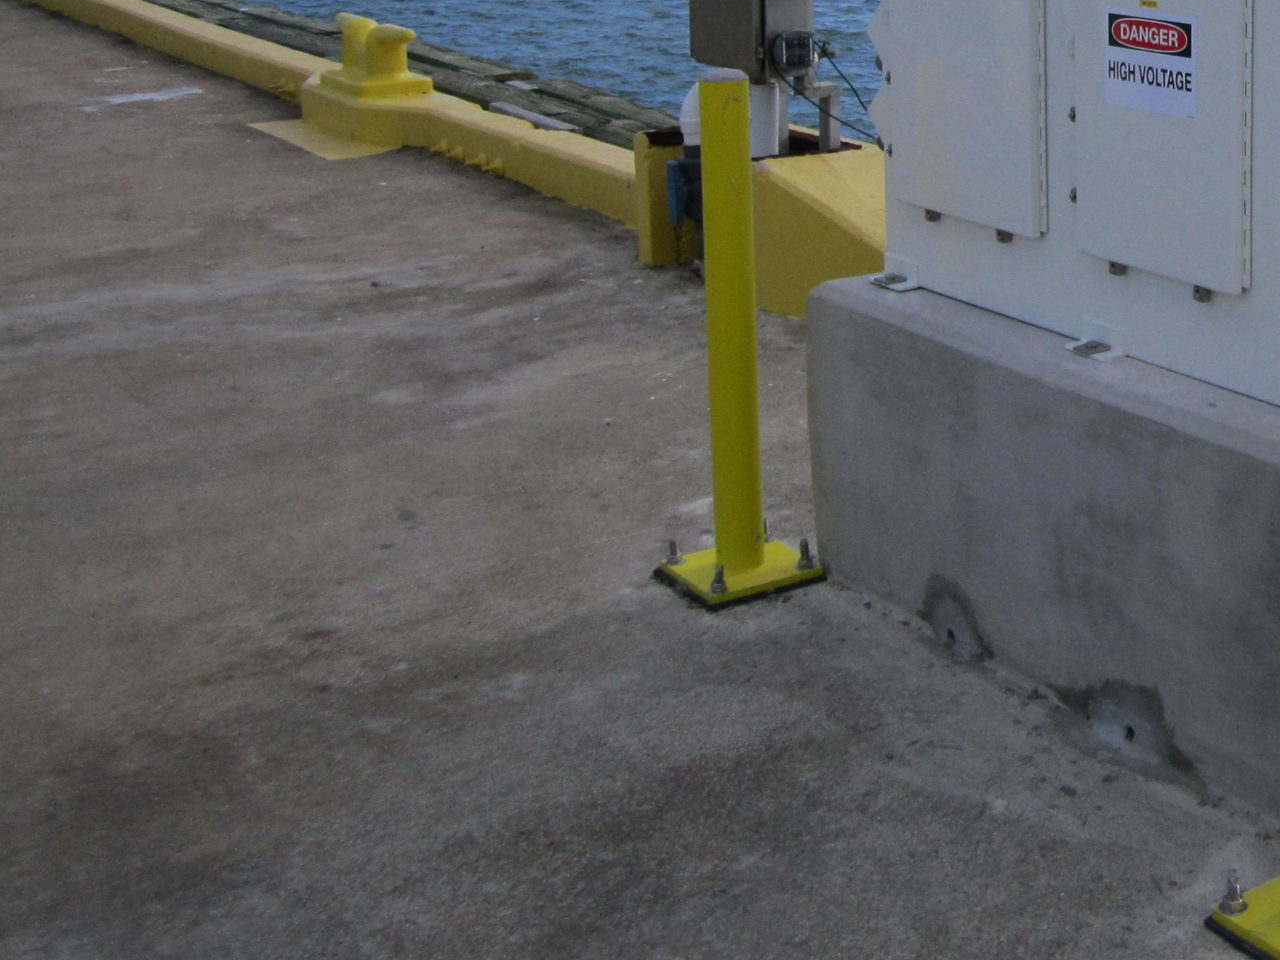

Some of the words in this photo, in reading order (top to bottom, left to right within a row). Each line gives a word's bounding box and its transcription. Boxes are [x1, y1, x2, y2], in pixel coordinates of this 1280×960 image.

[1120, 23, 1178, 47] DANGER
[1108, 59, 1136, 83] HIGH
[1139, 65, 1192, 92] VOLTAGE
